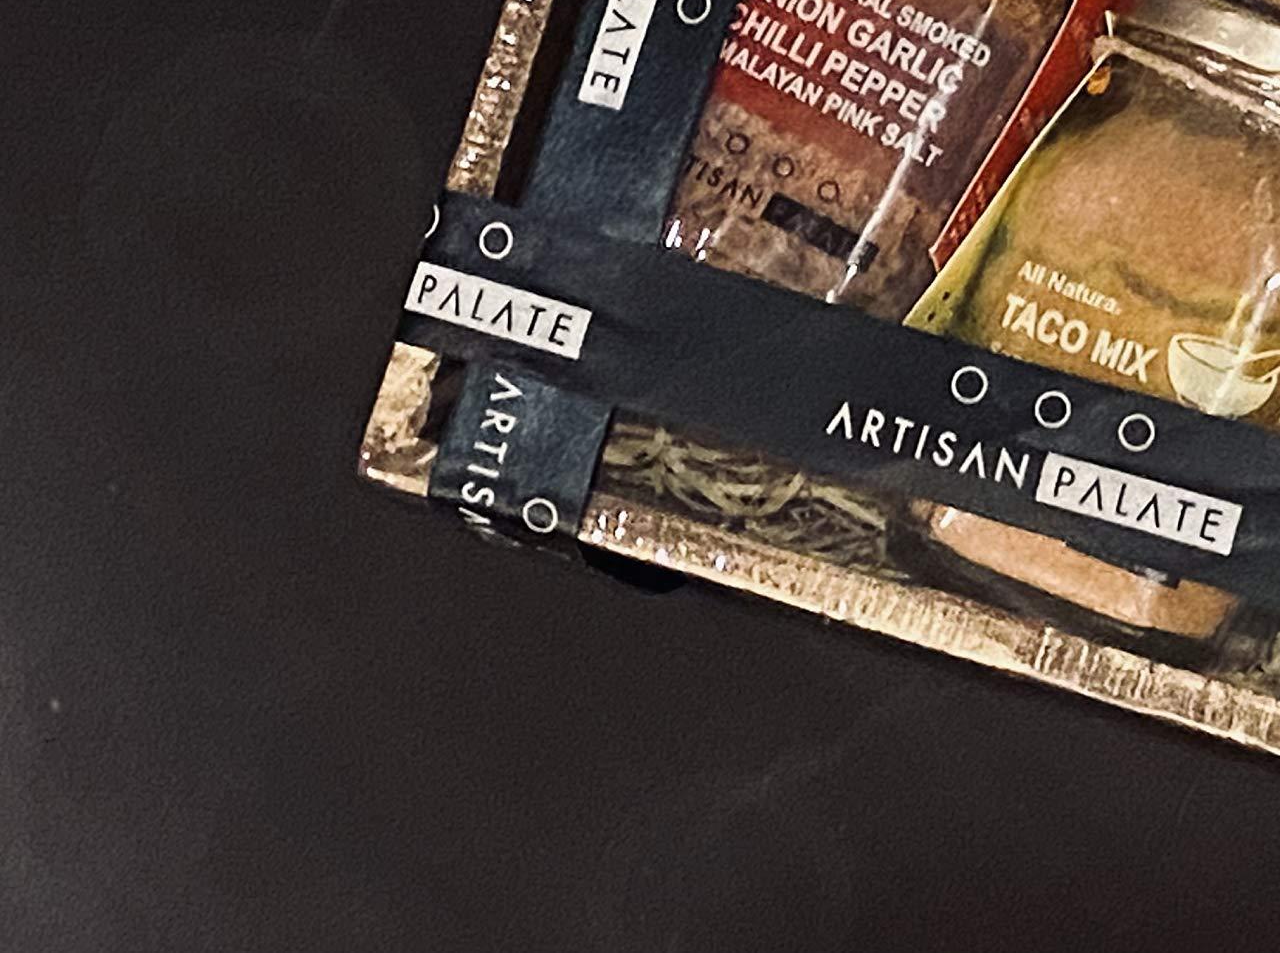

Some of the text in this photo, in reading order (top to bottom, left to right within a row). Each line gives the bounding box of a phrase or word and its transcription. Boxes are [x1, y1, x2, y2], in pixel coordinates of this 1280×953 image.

[846, 18, 964, 95] GARLIC
[896, 4, 991, 68] SMOKED
[821, 49, 946, 134] PEPPER
[821, 92, 884, 137] PINK
[880, 122, 944, 167] SALT
[417, 273, 574, 347] PALATE
[1017, 260, 1047, 286] All
[1001, 292, 1160, 384] TACO MIX
[825, 401, 1225, 544] ARTISAN PALATE
